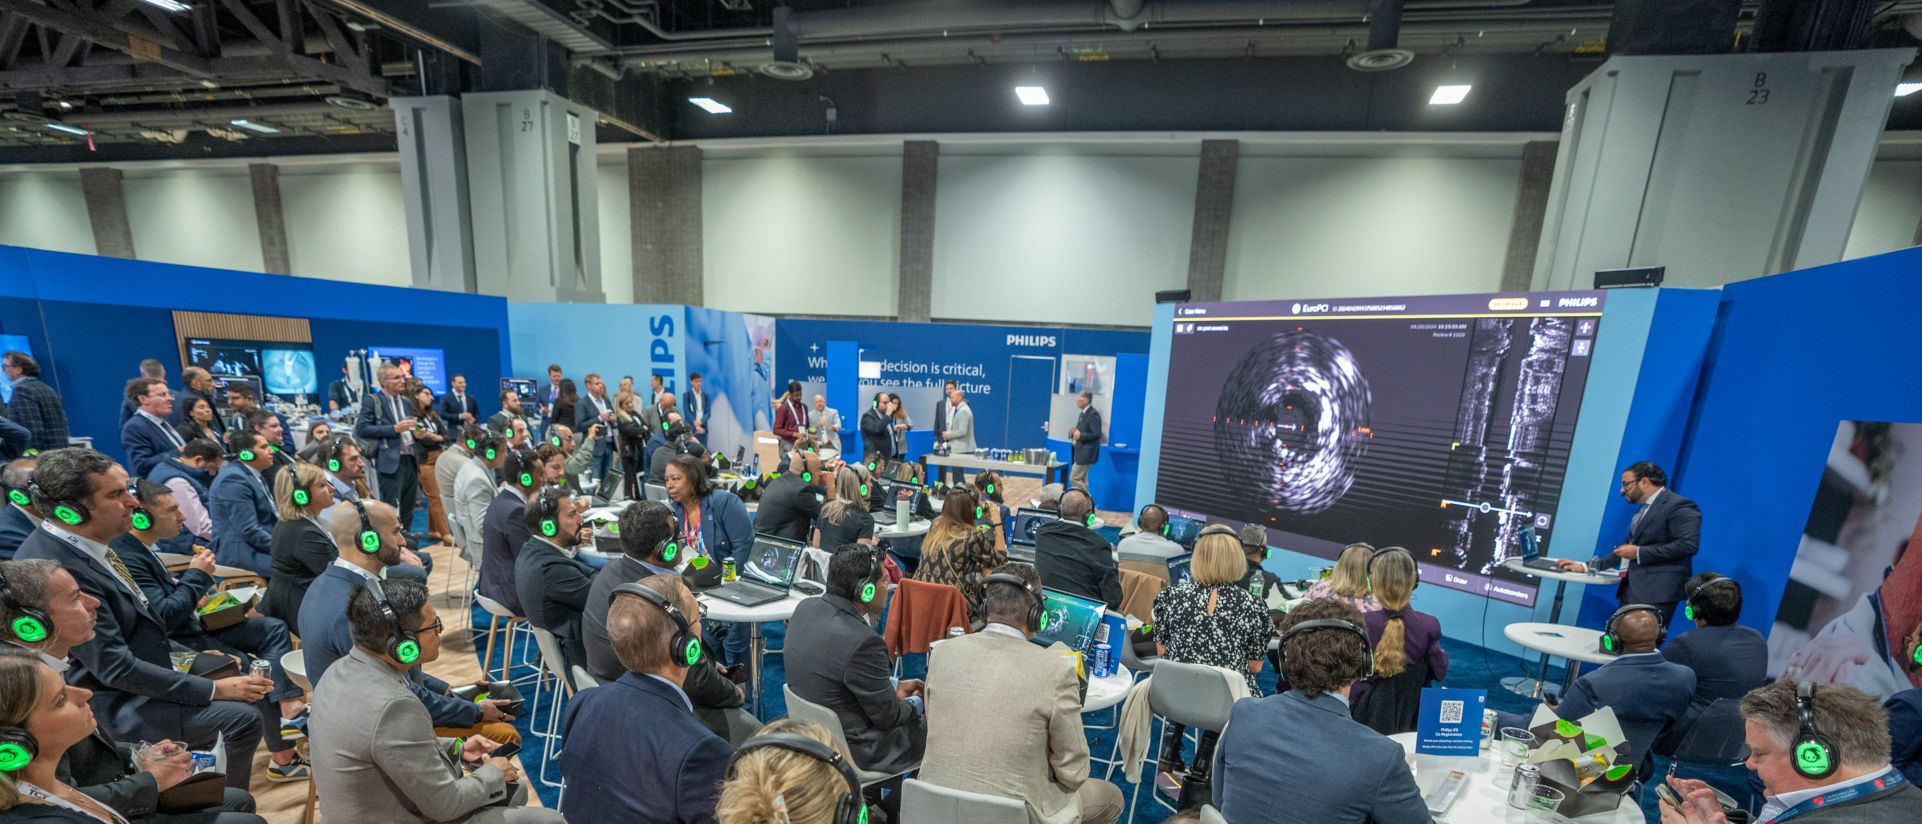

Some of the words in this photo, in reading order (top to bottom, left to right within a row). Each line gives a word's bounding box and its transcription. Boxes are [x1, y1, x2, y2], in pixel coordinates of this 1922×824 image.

[1754, 72, 1767, 87] B
[1745, 90, 1769, 105] 23
[521, 121, 533, 132] 27
[1302, 303, 1329, 313] EuroPCI
[1558, 297, 1598, 308] PHILIPS
[1006, 334, 1056, 348] PHILIPS
[649, 314, 676, 395] LIPS
[808, 356, 828, 369] Wh
[881, 359, 928, 374] decision
[931, 361, 940, 374] is
[942, 362, 986, 379] critical,
[880, 378, 899, 386] see
[902, 377, 923, 387] the
[926, 377, 944, 388] full
[956, 380, 991, 395] icture
[1493, 585, 1529, 599] Autoborders
[29, 788, 50, 800] TCT
